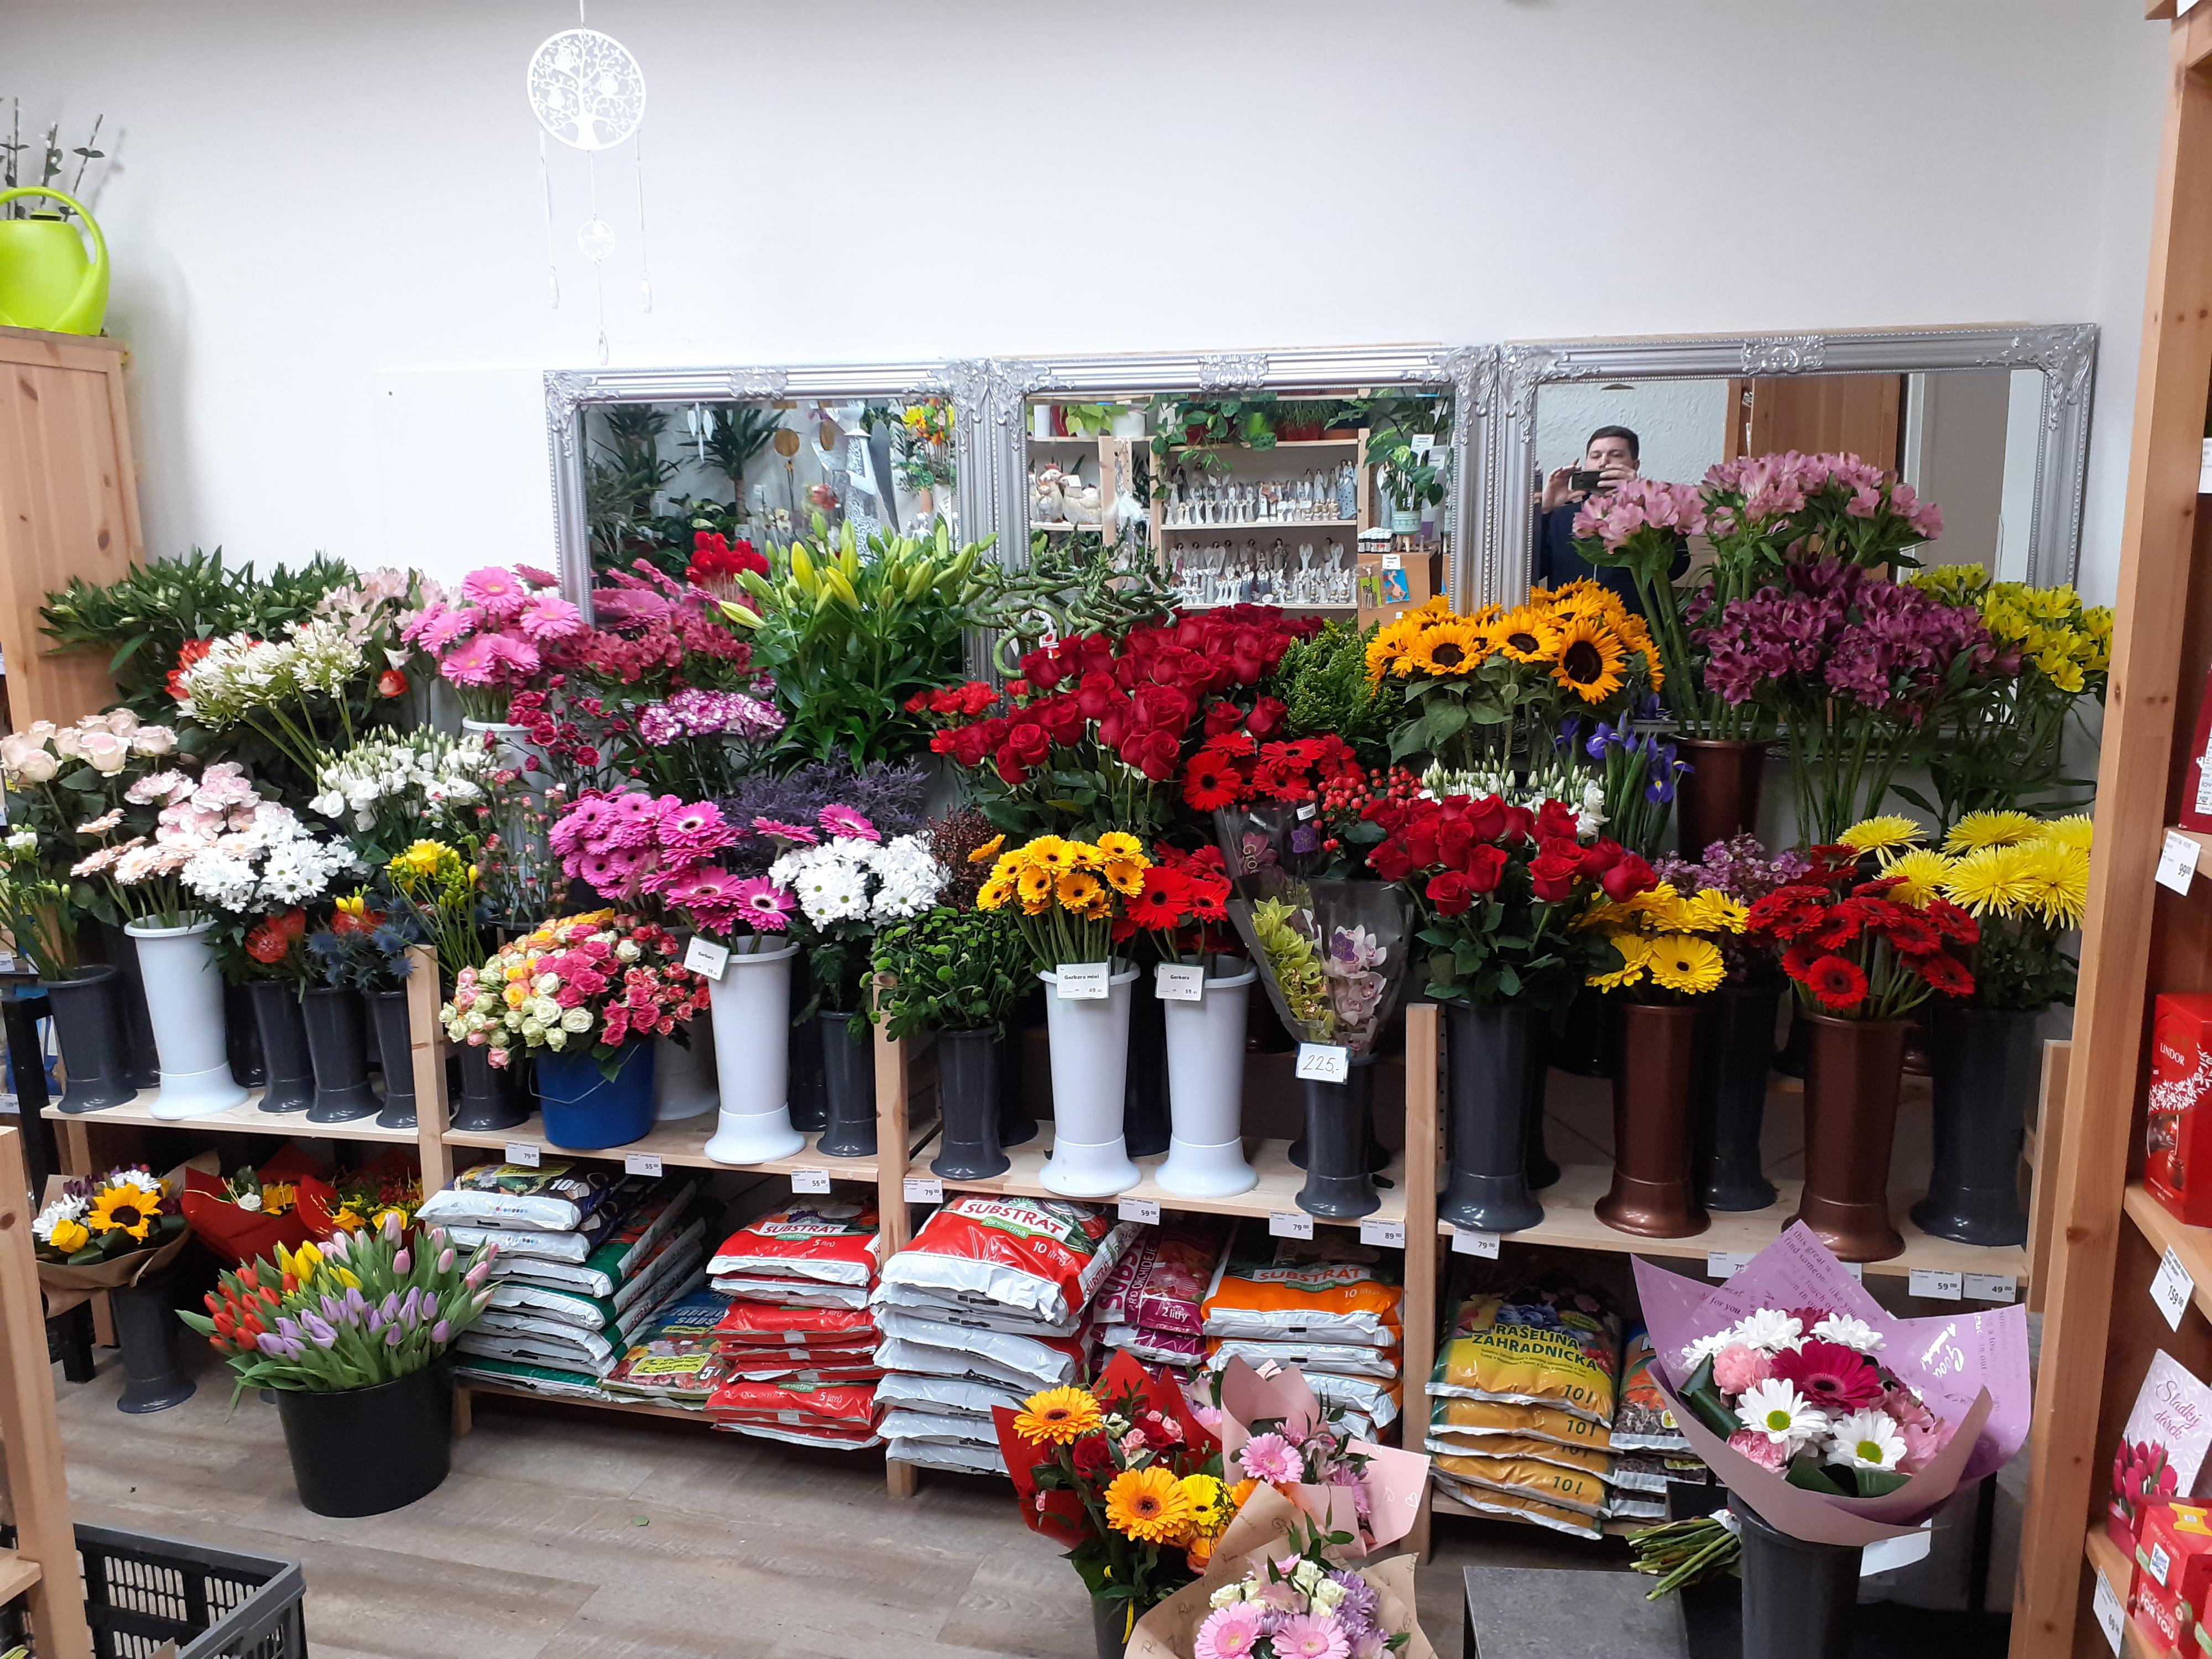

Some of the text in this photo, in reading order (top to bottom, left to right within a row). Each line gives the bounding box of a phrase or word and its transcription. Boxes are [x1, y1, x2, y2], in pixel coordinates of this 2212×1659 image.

[698, 951, 714, 961] Gerbera
[2160, 1042, 2185, 1067] LINDOR
[1302, 1055, 1339, 1074] 225,-
[549, 1178, 575, 1191] 10
[763, 1224, 841, 1234] SUBSTRÁT
[964, 1203, 1064, 1237] SUBSTRÁT
[1032, 1241, 1048, 1254] 10
[1793, 1230, 1825, 1265] this great
[1135, 1245, 1158, 1290] ORCHIDEJE
[1258, 1264, 1364, 1283] SUBSTRÁT
[1784, 1237, 1801, 1254] find
[1799, 1254, 1827, 1284] someon
[1829, 1287, 1844, 1302] like
[1840, 1302, 1857, 1318] you
[1344, 1288, 1358, 1298] 10
[1799, 1291, 1808, 1300] in
[1806, 1280, 1825, 1302] touch
[2167, 1285, 2179, 1305] 159
[1161, 1308, 1188, 1322] 2 litry
[1709, 1296, 1741, 1315] for you
[1495, 1324, 1579, 1350] RAŠELINA
[699, 1366, 716, 1380] 5
[819, 1391, 827, 1401] 5
[1564, 1384, 1594, 1404] 10 l
[2156, 1380, 2203, 1430] Sladký
[1567, 1420, 1586, 1434] 10
[2154, 1410, 2184, 1440] dárek
[1553, 1475, 1573, 1491] 10
[2140, 1593, 2174, 1641] FOR YOU
